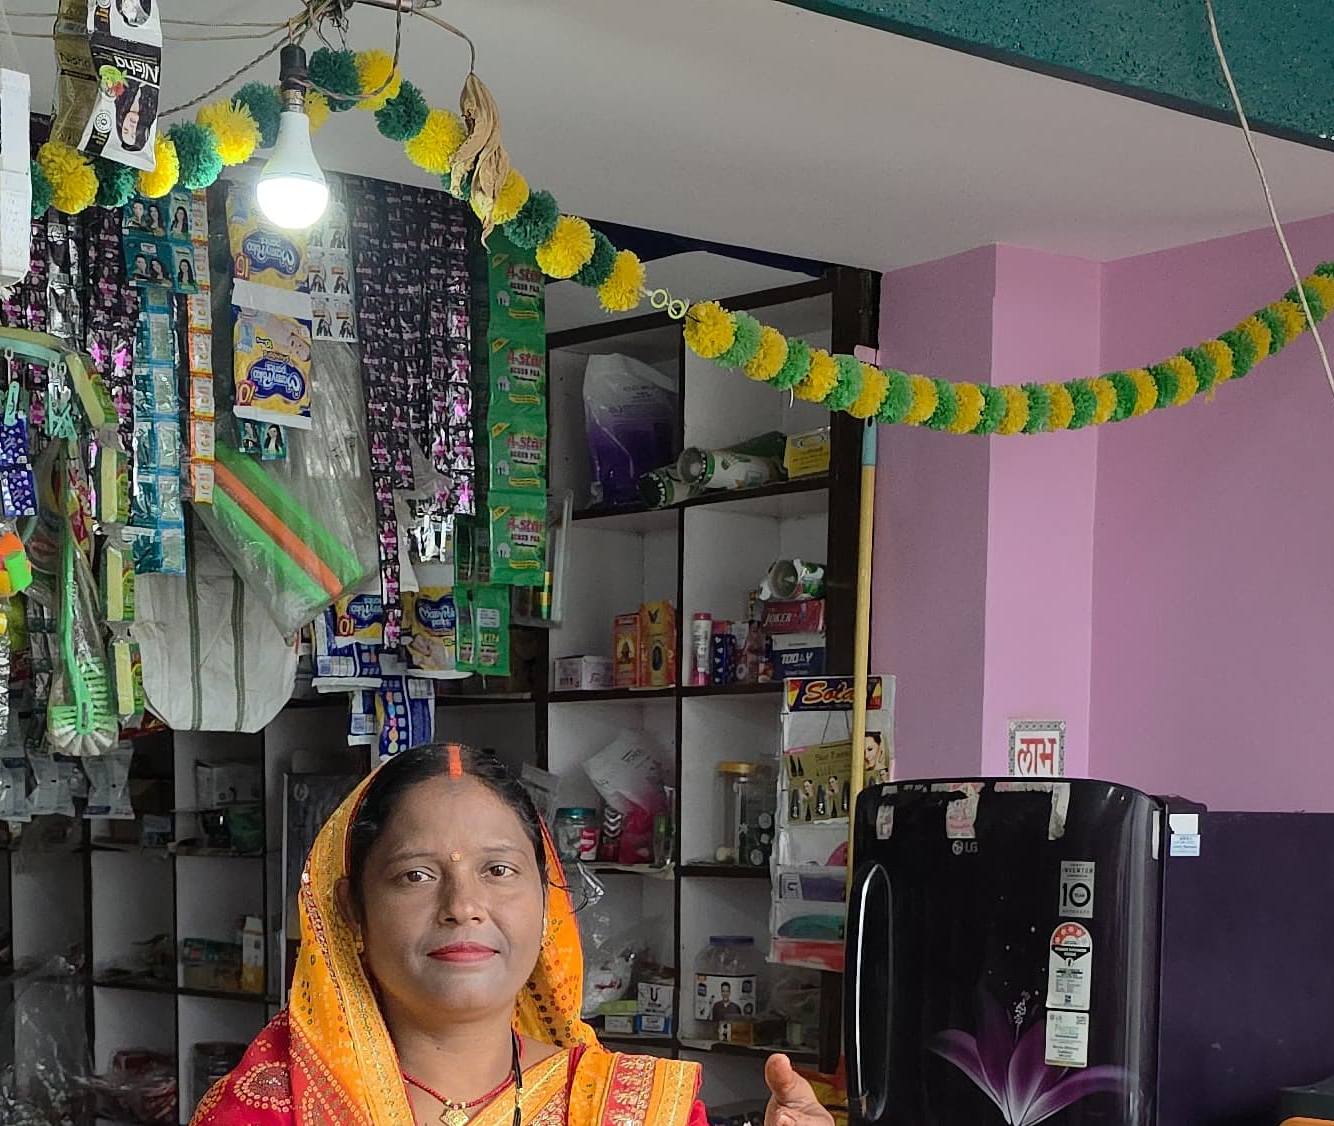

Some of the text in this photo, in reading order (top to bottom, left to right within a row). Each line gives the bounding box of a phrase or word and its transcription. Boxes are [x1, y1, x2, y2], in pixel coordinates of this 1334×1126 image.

[115, 54, 160, 84] Nisha
[764, 611, 793, 628] JOKER
[801, 679, 855, 705] Sola
[1017, 737, 1057, 776] लाभ
[965, 841, 978, 852] LG
[1062, 882, 1091, 908] 10
